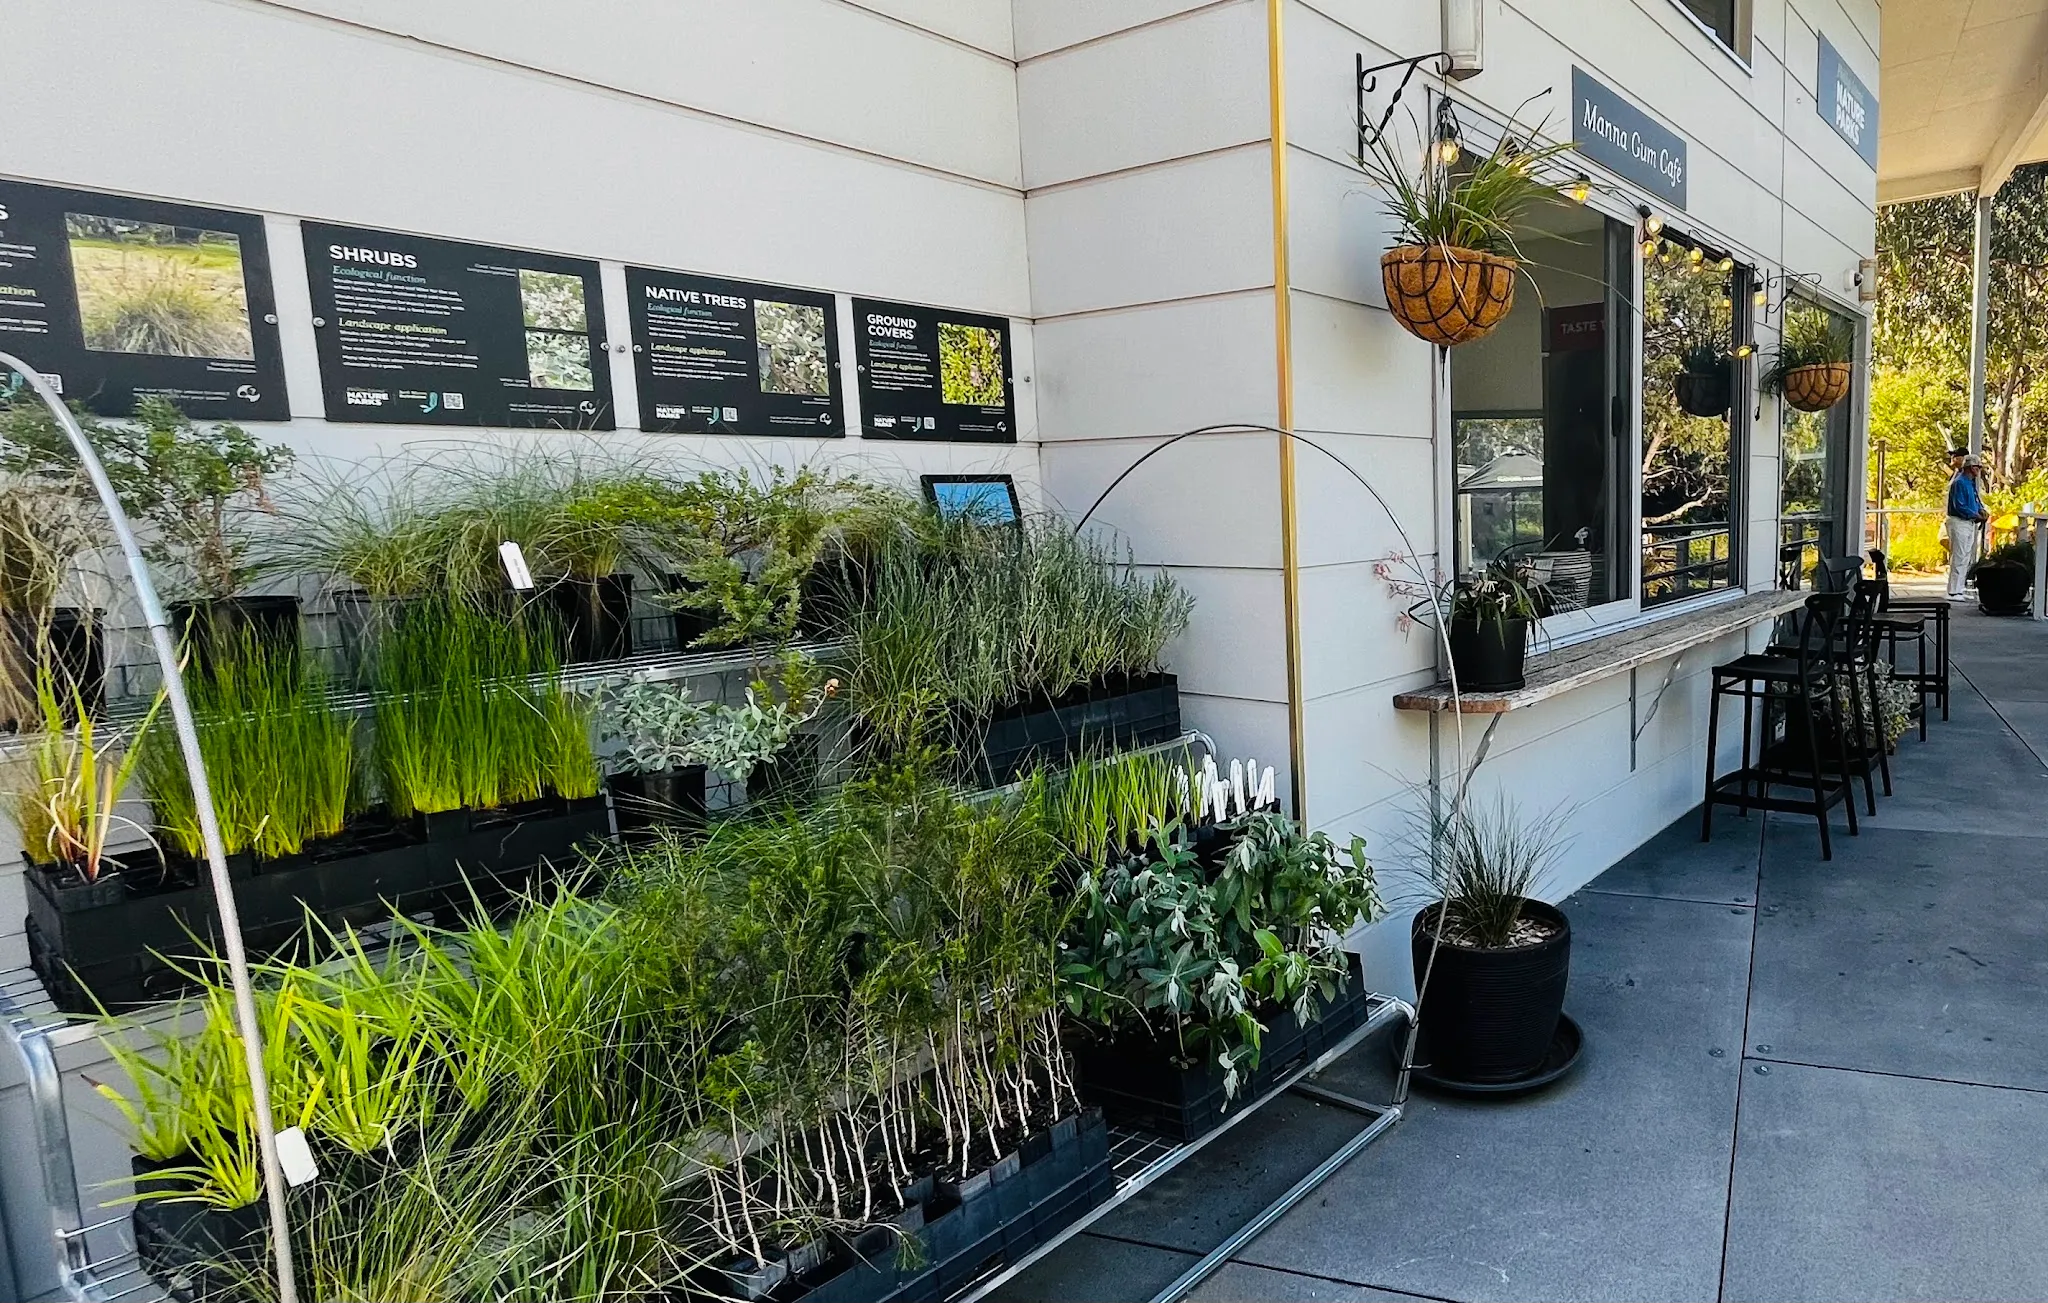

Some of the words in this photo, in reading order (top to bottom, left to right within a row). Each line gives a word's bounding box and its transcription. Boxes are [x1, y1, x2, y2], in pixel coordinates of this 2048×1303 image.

[1836, 80, 1866, 130] NATURE
[1835, 103, 1860, 146] PARKS
[1582, 98, 1628, 152] Manna
[1631, 131, 1657, 169] Gum
[1660, 149, 1682, 188] Café
[329, 244, 418, 269] SHRUBS
[332, 265, 383, 280] Ecological
[384, 271, 427, 285] function
[645, 285, 700, 304] NATIVE
[702, 292, 747, 310] TREES
[338, 317, 391, 331] Landscape
[394, 324, 448, 336] application
[867, 313, 917, 329] GROUND
[1561, 320, 1597, 335] TASTE
[868, 325, 914, 340] COVERS
[650, 342, 687, 354] Landscape
[689, 347, 727, 357] application
[346, 391, 390, 401] NATURE
[347, 398, 383, 406] PARKS
